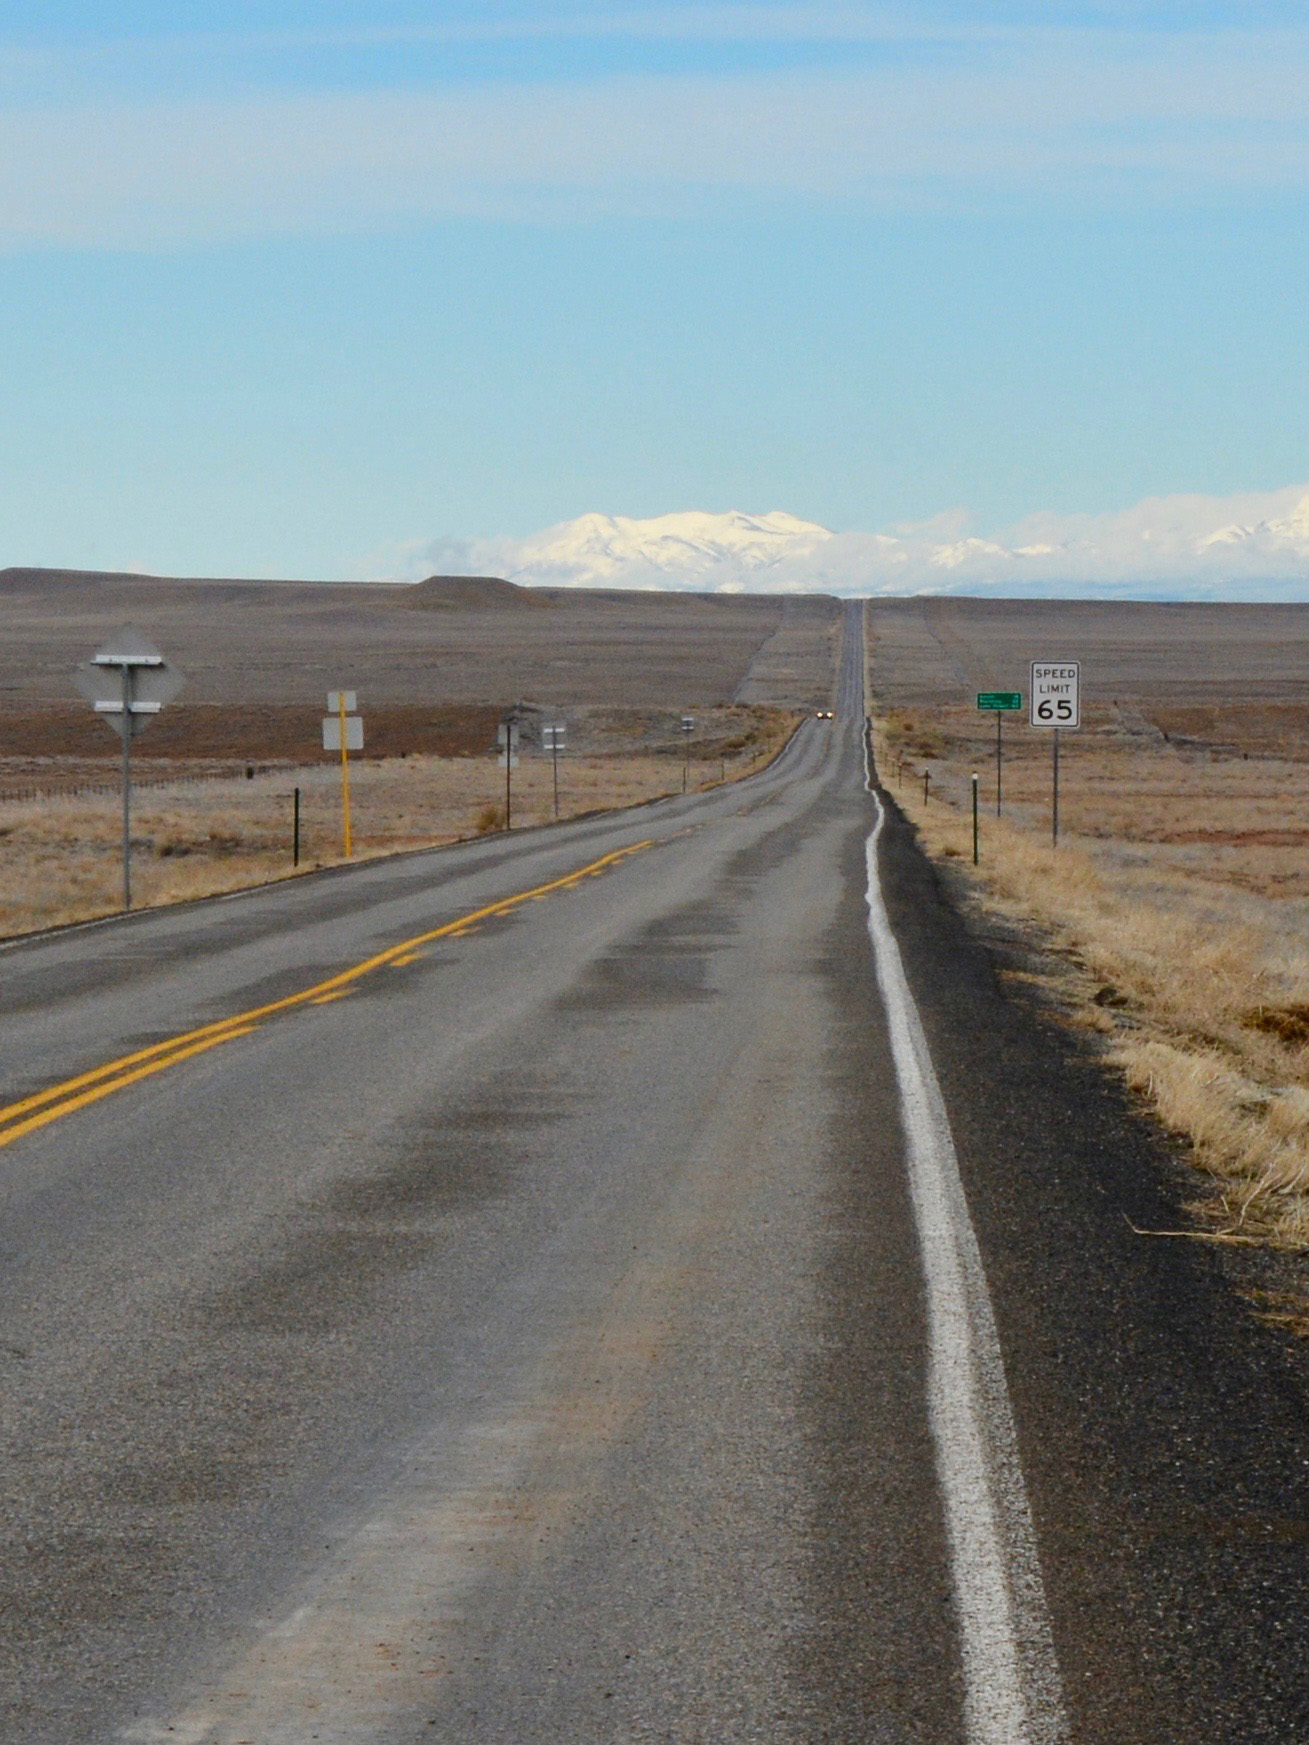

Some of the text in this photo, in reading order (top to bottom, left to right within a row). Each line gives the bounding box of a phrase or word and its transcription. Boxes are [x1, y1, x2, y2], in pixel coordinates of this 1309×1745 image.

[1035, 668, 1076, 679] SPEED
[1039, 684, 1071, 694] LIMIT
[1037, 699, 1073, 720] 65
